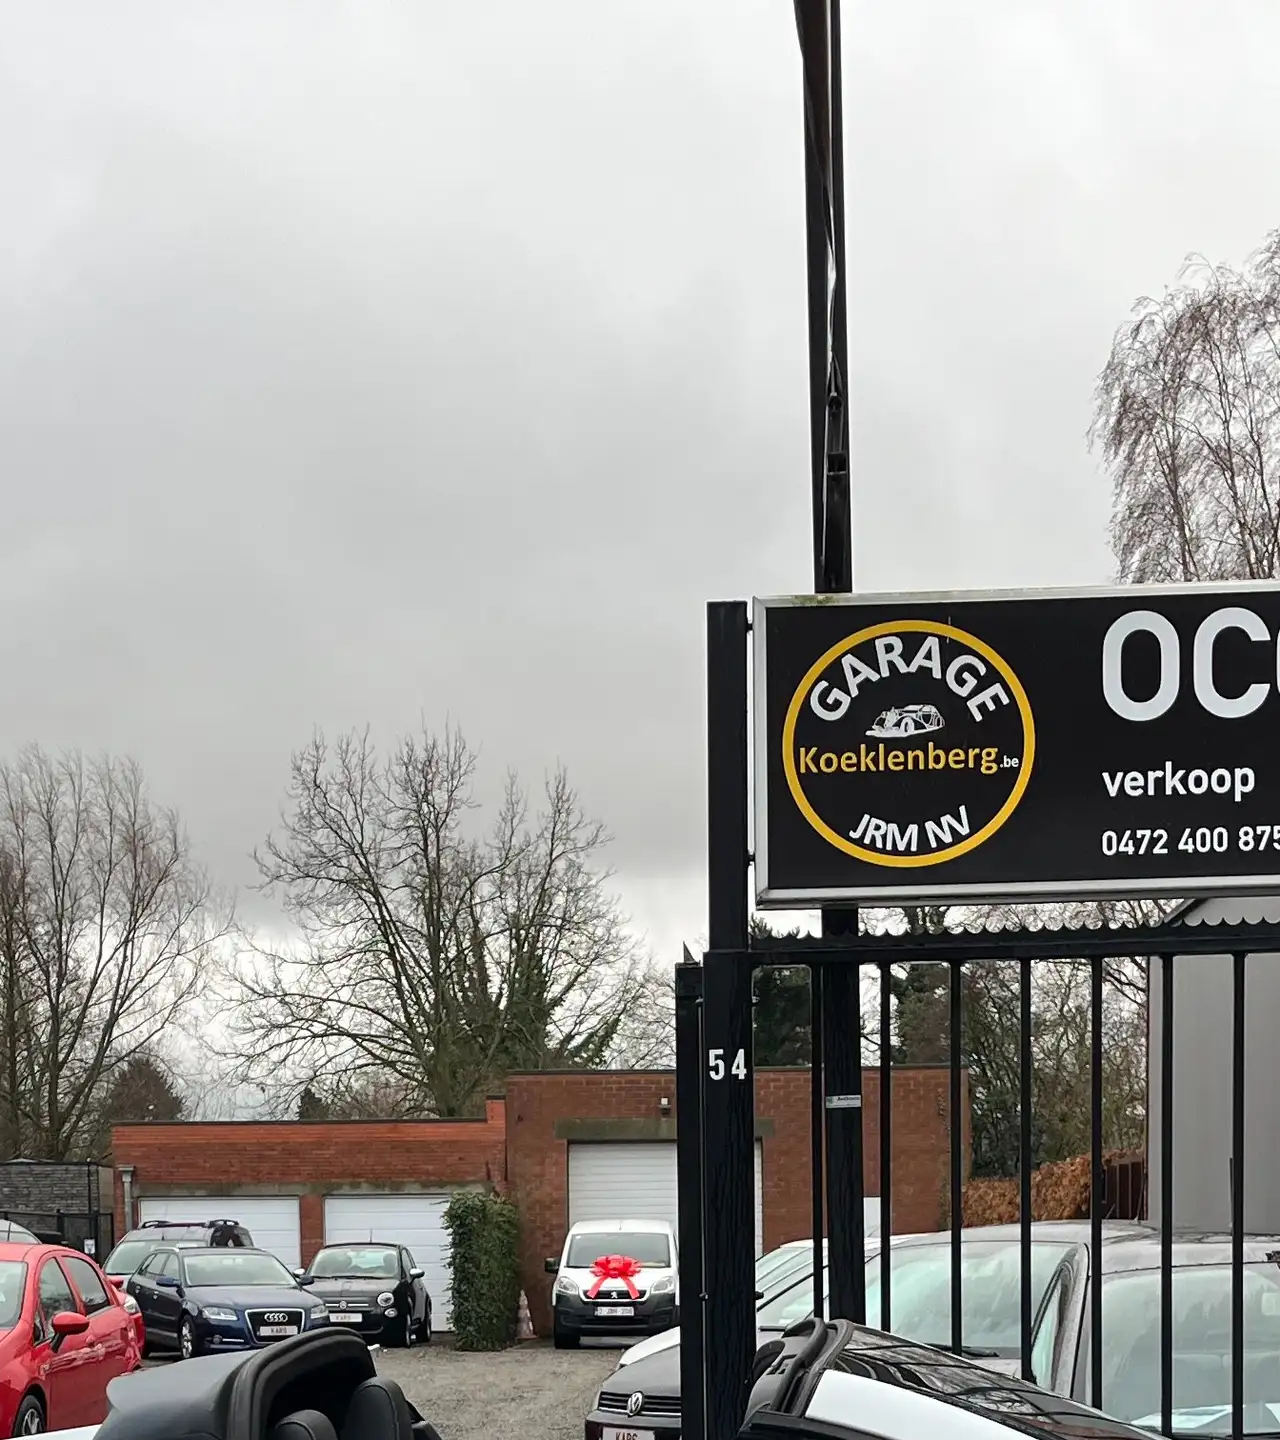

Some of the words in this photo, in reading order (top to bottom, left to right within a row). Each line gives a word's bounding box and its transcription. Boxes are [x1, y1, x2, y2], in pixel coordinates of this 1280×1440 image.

[810, 635, 1010, 722] GARAGE
[1102, 761, 1255, 802] verkoop
[849, 814, 918, 852] JRM
[924, 805, 970, 848] NV
[1102, 828, 1169, 856] 0472
[1177, 826, 1229, 854] 400
[708, 1048, 747, 1081] 54
